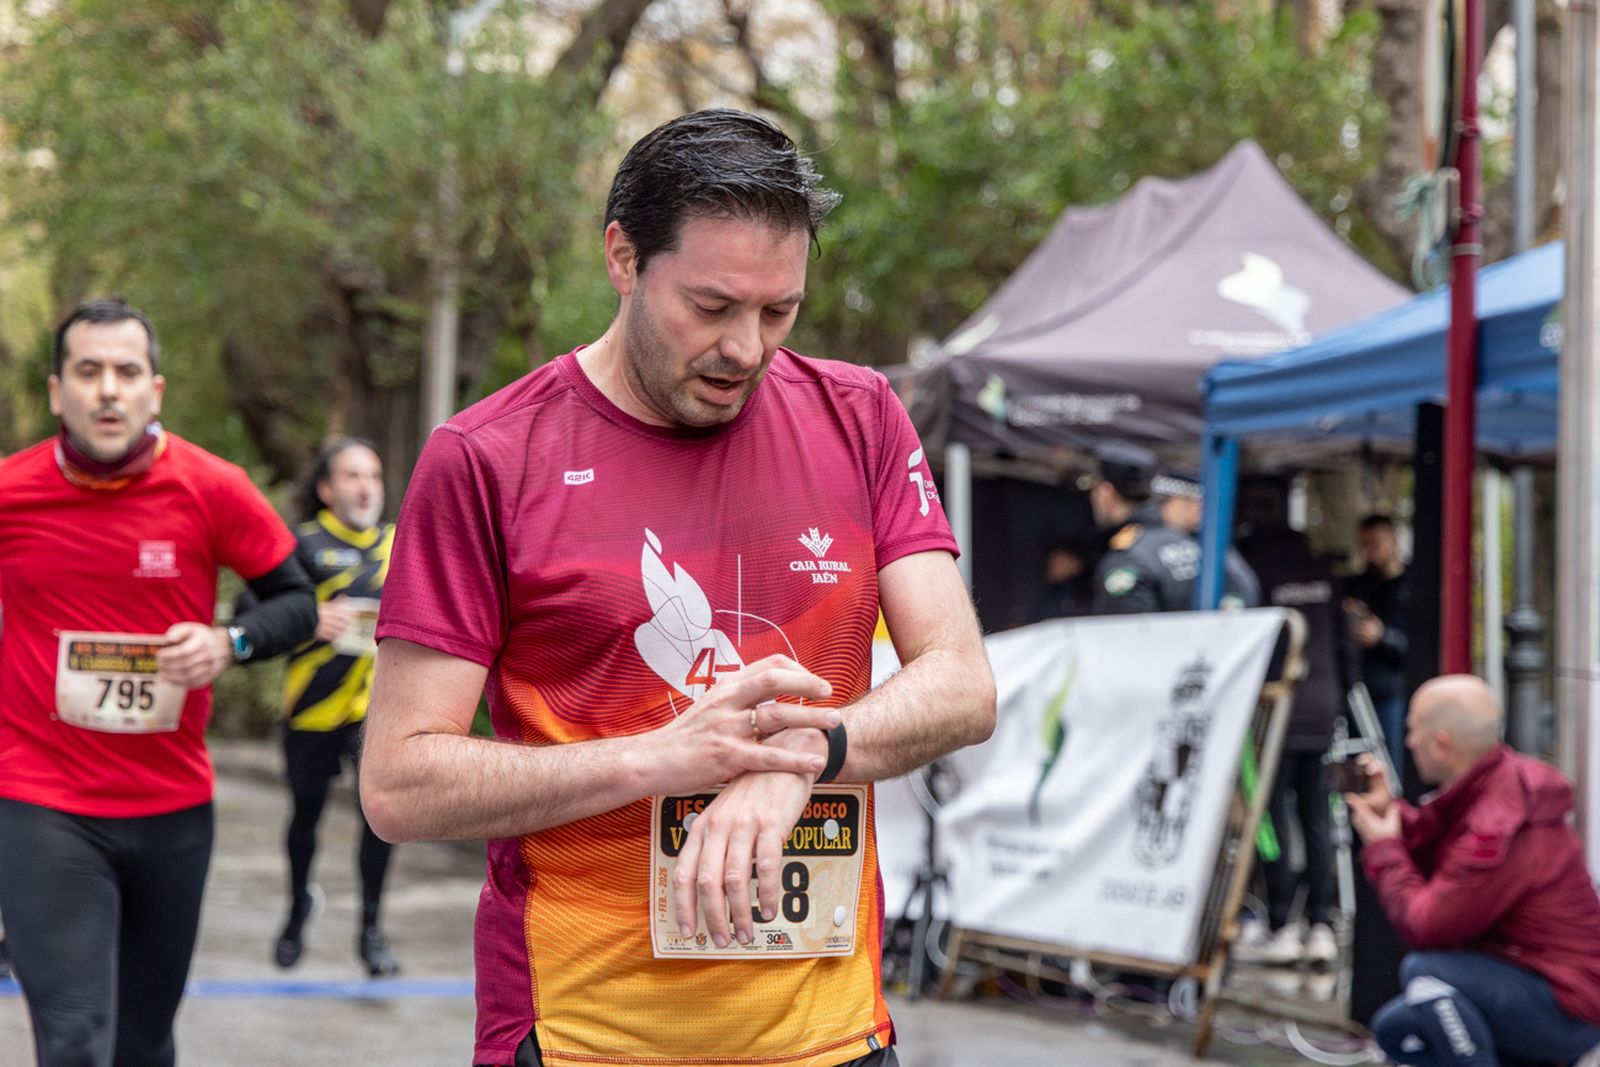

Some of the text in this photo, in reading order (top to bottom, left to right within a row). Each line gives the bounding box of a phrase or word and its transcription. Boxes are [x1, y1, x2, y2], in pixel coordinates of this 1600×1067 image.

[790, 561, 851, 571] CAJA RURAL
[96, 679, 154, 710] 795
[670, 827, 684, 849] V
